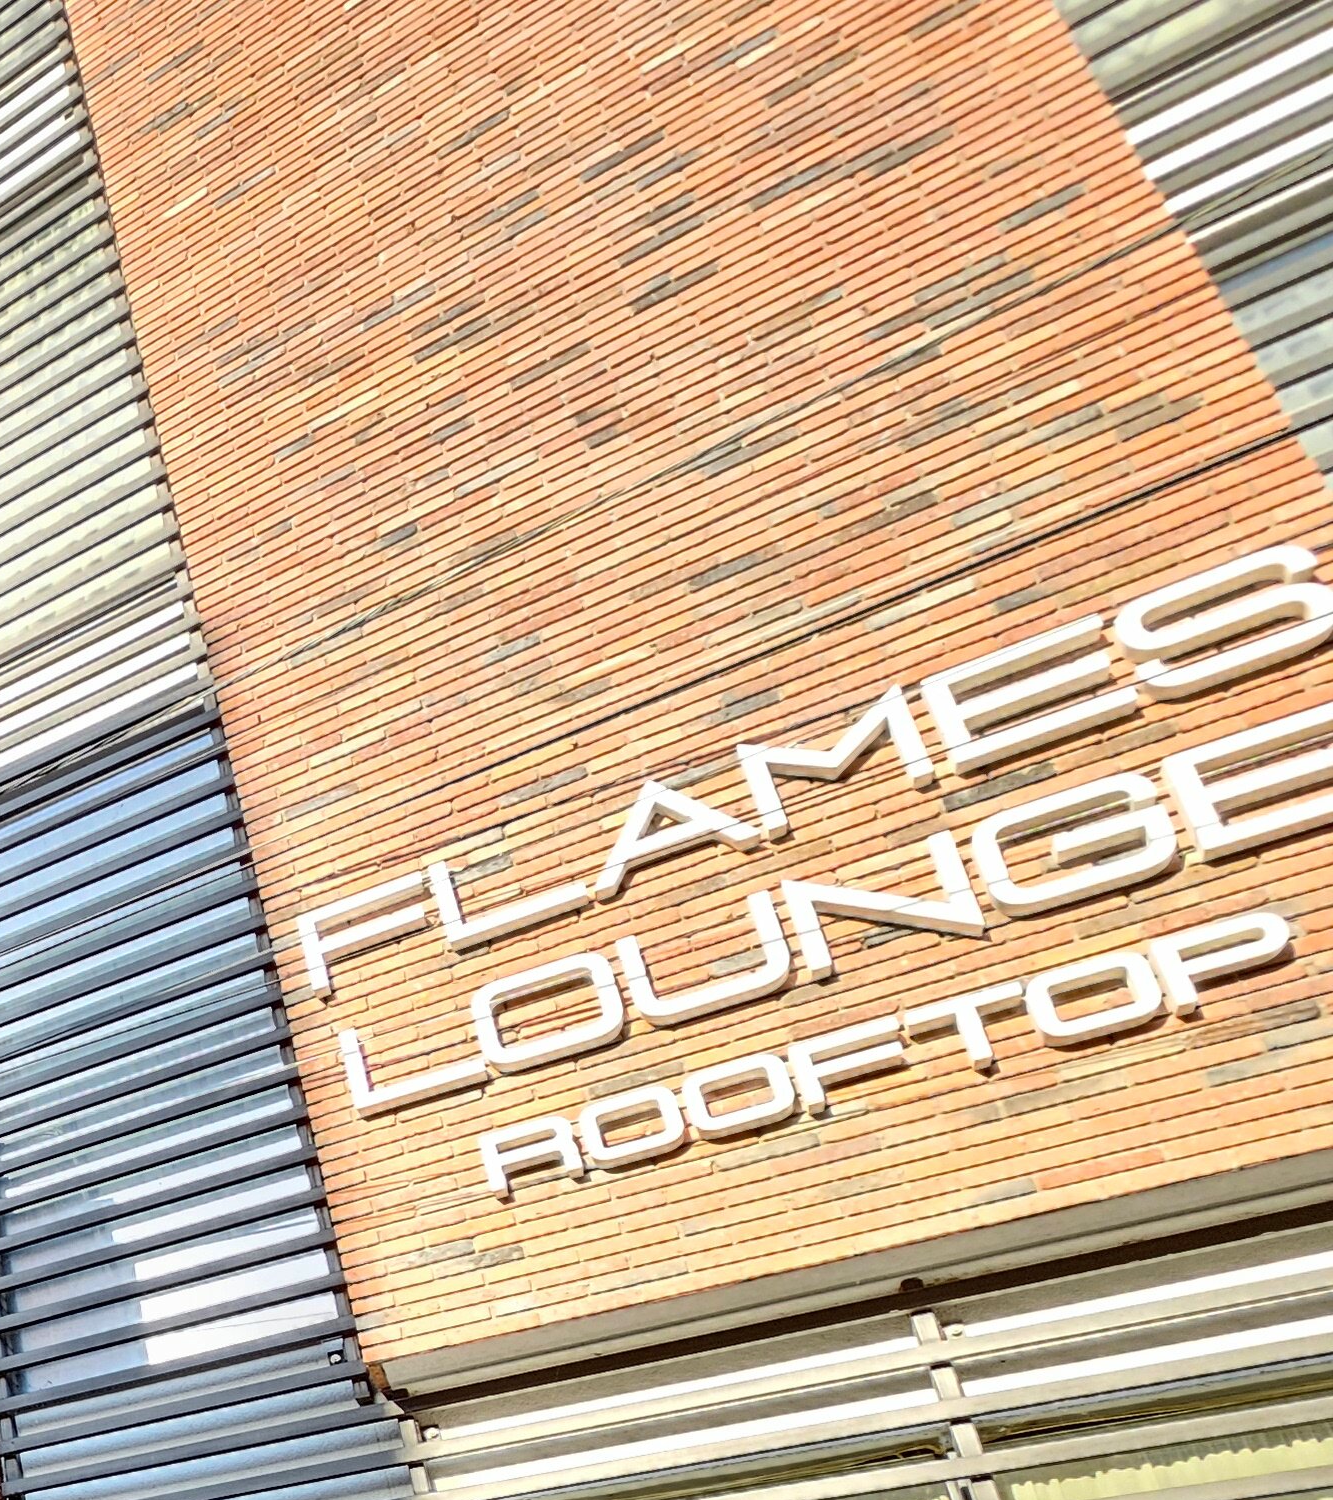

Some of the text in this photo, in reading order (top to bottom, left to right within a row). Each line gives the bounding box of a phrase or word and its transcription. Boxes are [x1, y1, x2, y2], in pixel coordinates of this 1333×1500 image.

[297, 544, 1333, 1000] FLAMES
[338, 700, 1333, 1120] LOUNGE
[478, 912, 1290, 1200] ROOFTOP
